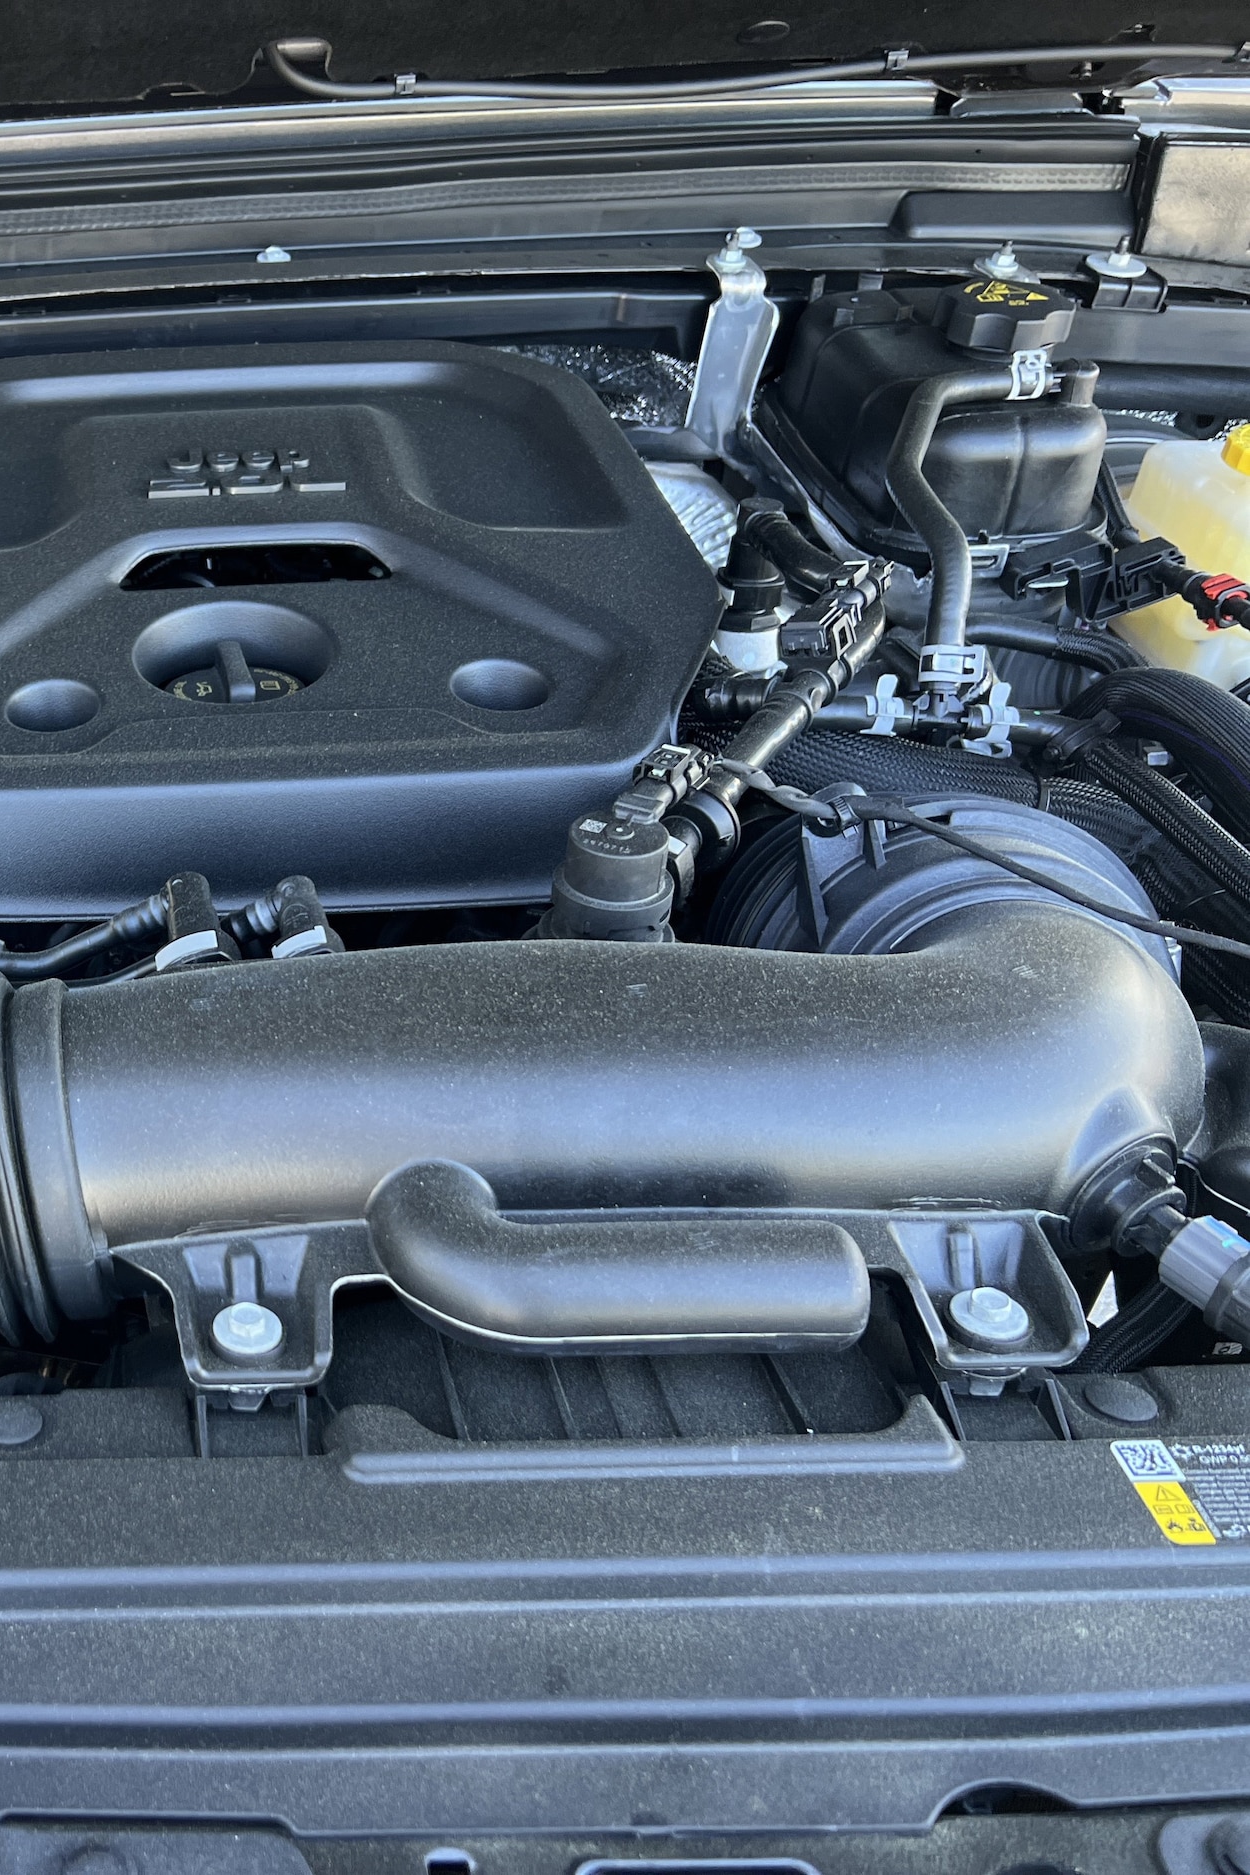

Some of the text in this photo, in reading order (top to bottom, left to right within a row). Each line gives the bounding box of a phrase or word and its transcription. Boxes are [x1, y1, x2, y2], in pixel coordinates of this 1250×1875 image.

[166, 447, 310, 475] Jeep
[147, 474, 347, 499] 2.0L
[1199, 1455, 1227, 1464] GWP
